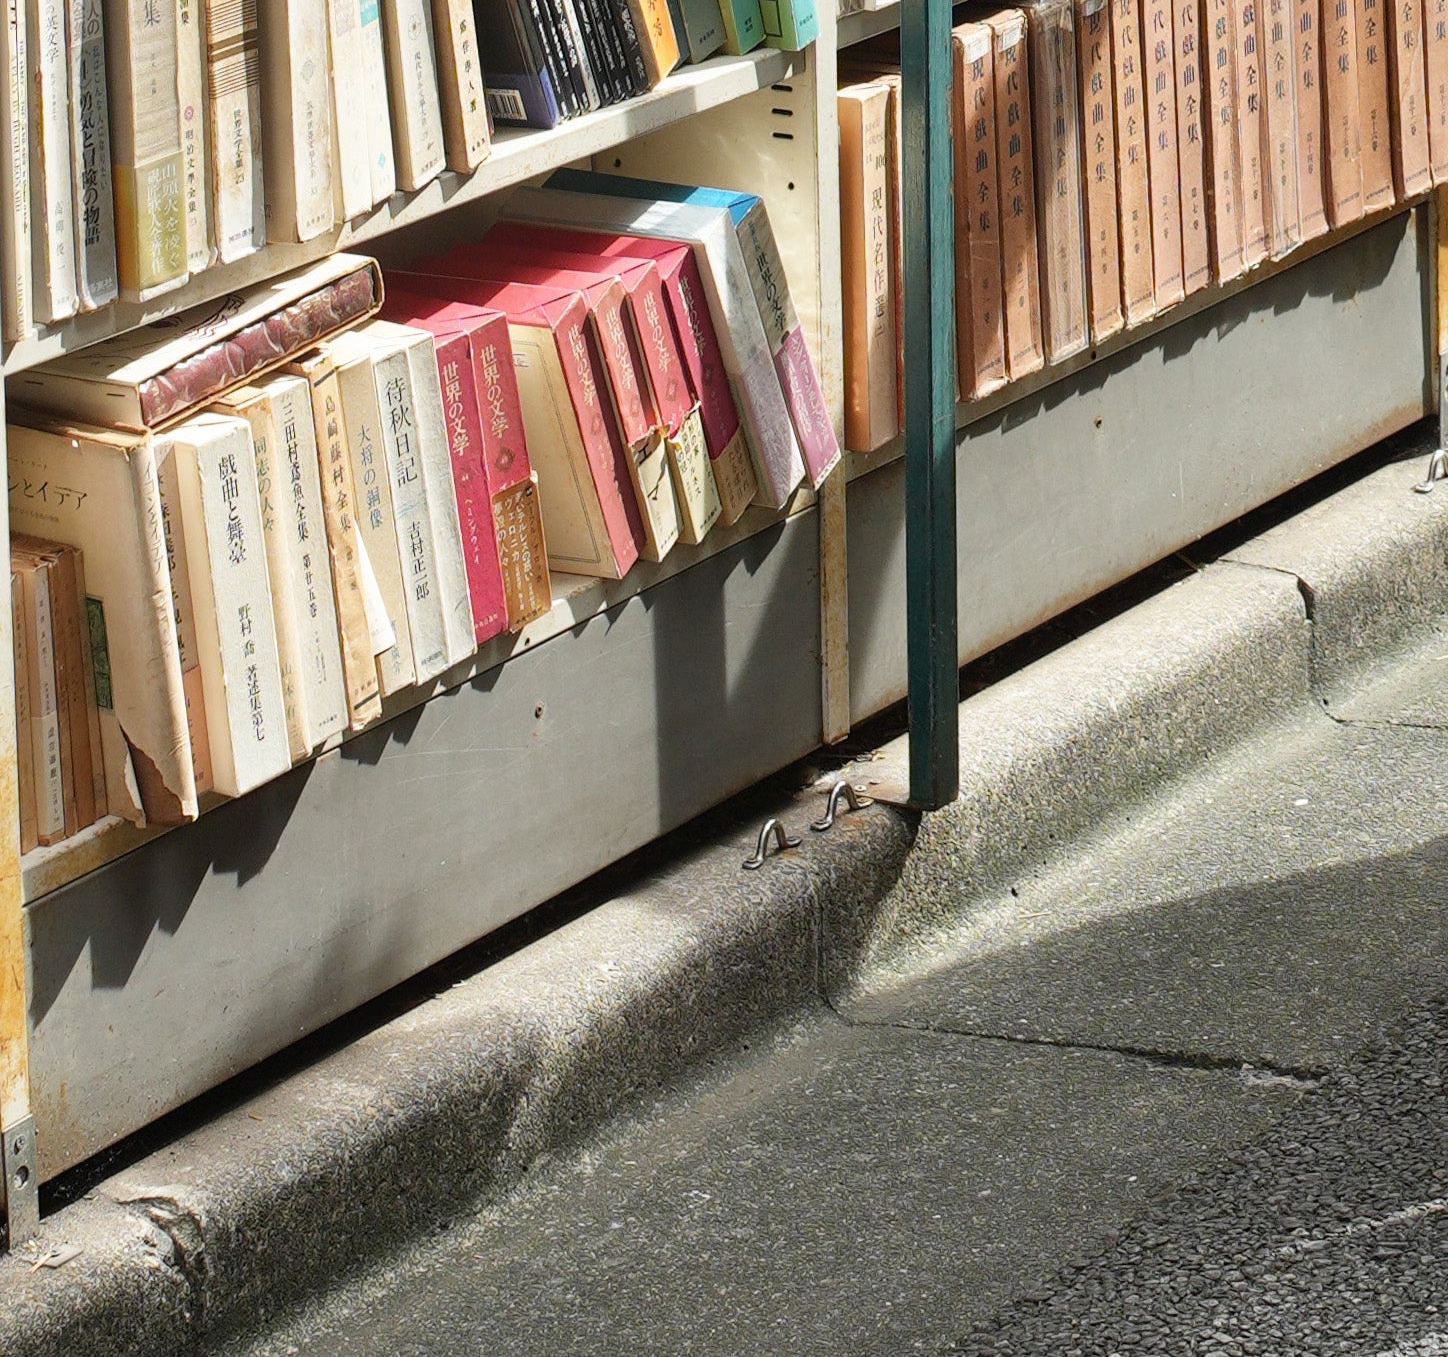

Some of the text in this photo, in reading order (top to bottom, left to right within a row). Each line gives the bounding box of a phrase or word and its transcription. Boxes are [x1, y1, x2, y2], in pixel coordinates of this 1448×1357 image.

[605, 307, 634, 390] 世界の文学
[643, 290, 670, 374] 世界の文学
[677, 273, 706, 358] 世界の文学
[479, 344, 508, 439] 世界の文学
[567, 322, 596, 407] 世界の文学
[384, 377, 419, 487] 待秋日記
[441, 361, 470, 457] 世界の文学
